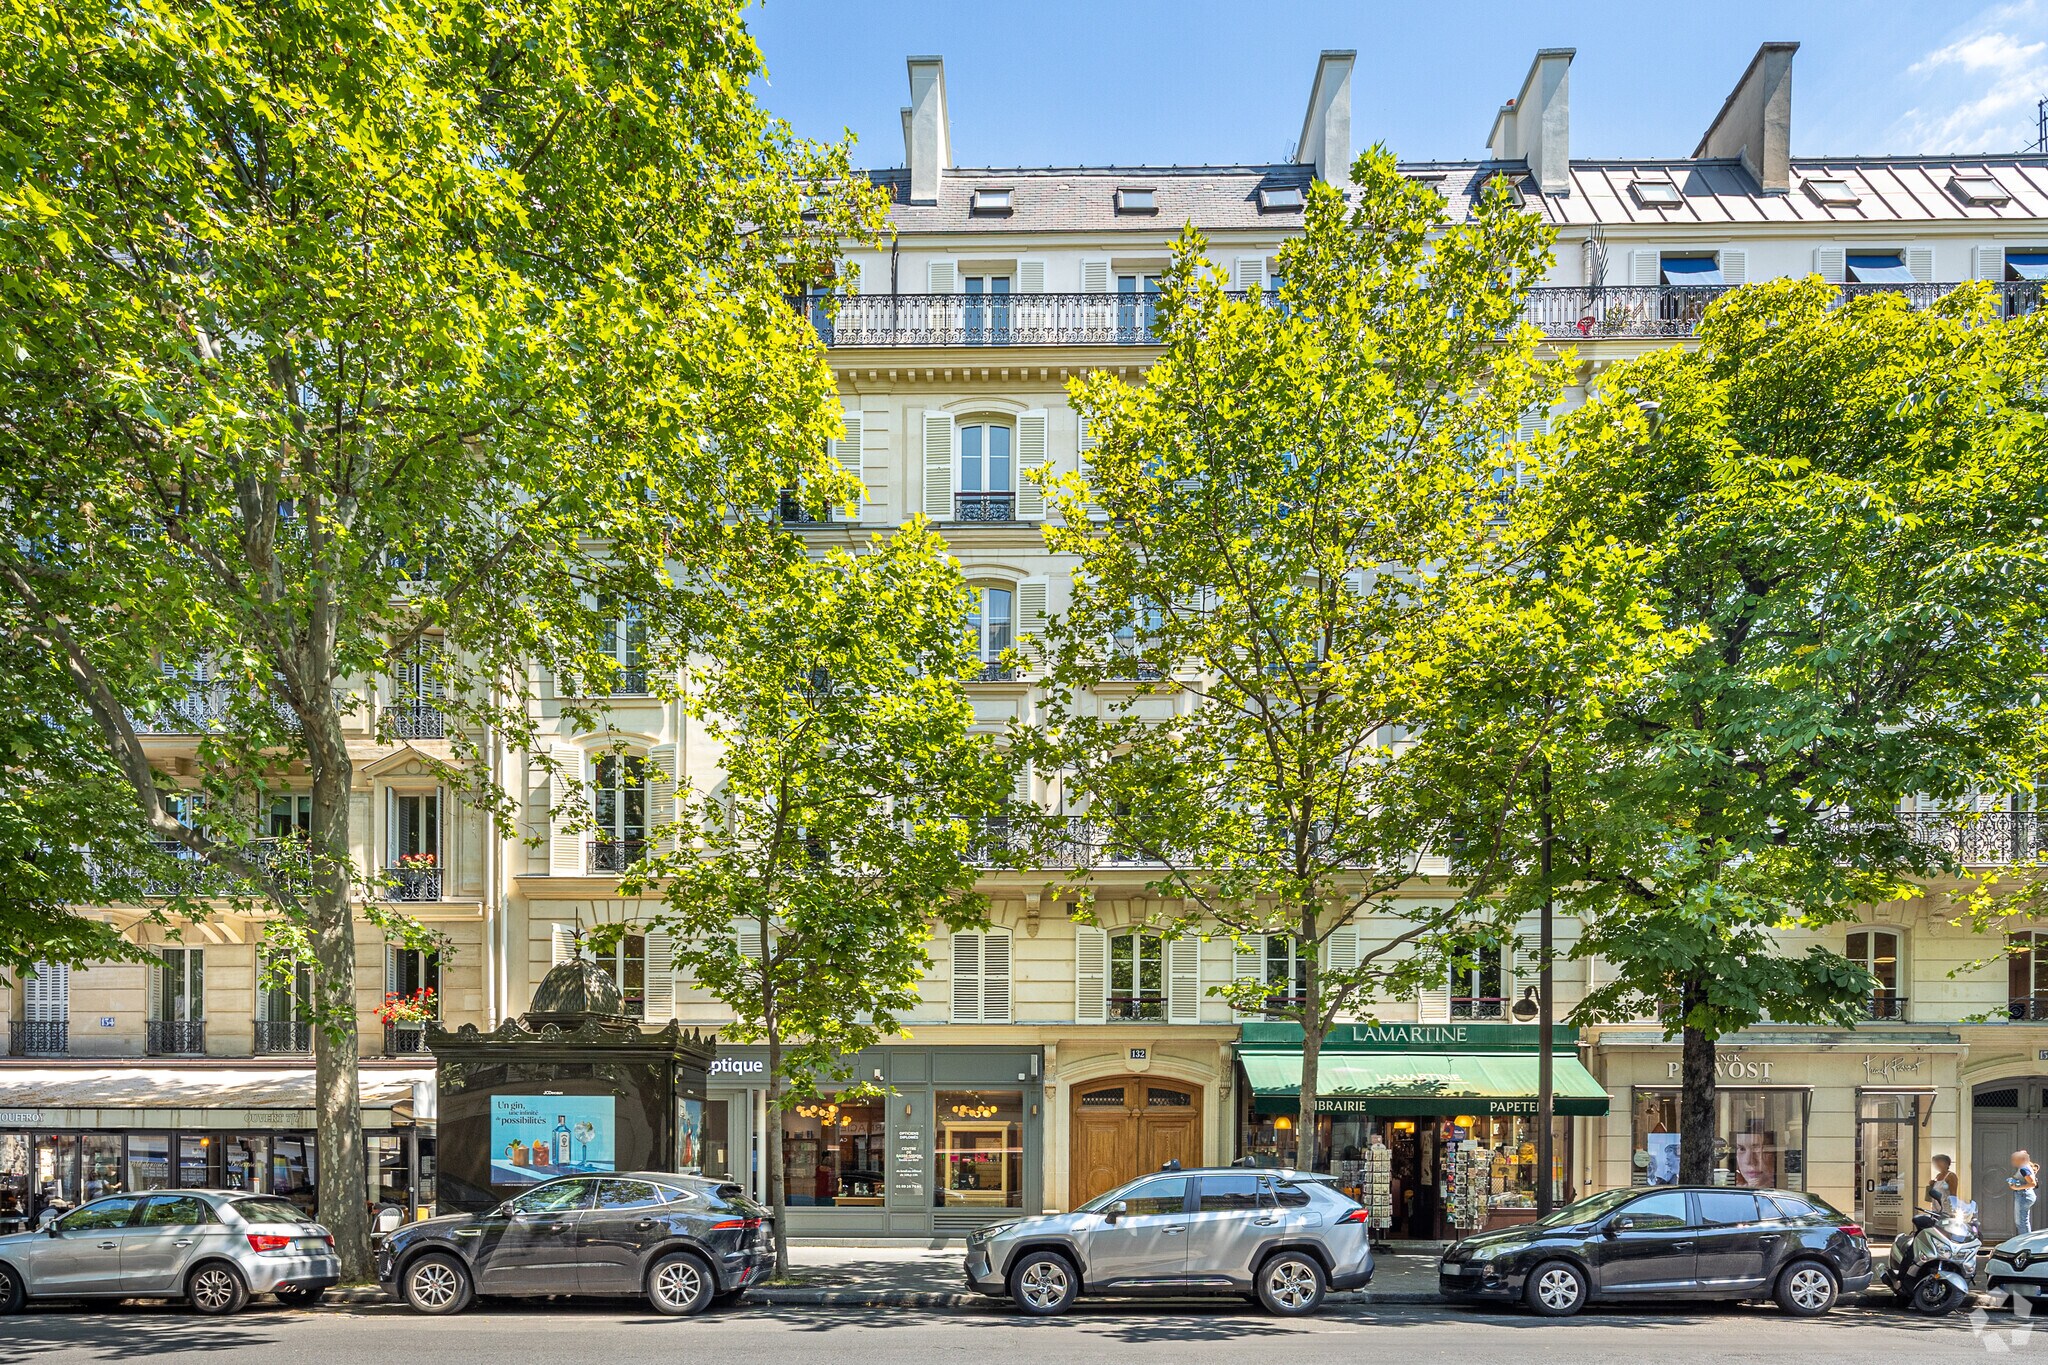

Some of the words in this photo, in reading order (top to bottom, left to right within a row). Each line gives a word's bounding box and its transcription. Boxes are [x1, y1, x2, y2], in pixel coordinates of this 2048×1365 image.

[1352, 1026, 1468, 1042] LAMARTINE
[1132, 1050, 1145, 1058] 132
[710, 1057, 763, 1076] ptique
[1667, 1062, 1774, 1079] PVOST
[1375, 1073, 1462, 1081] LAMARTINE
[497, 1101, 509, 1110] Un
[510, 1101, 526, 1111] gin,
[1314, 1100, 1366, 1112] IBRAIRIE
[1490, 1101, 1555, 1112] PAPETE
[0, 1113, 45, 1122] OUFFROY
[244, 1113, 284, 1122] OUVERT
[501, 1116, 547, 1126] possibilités
